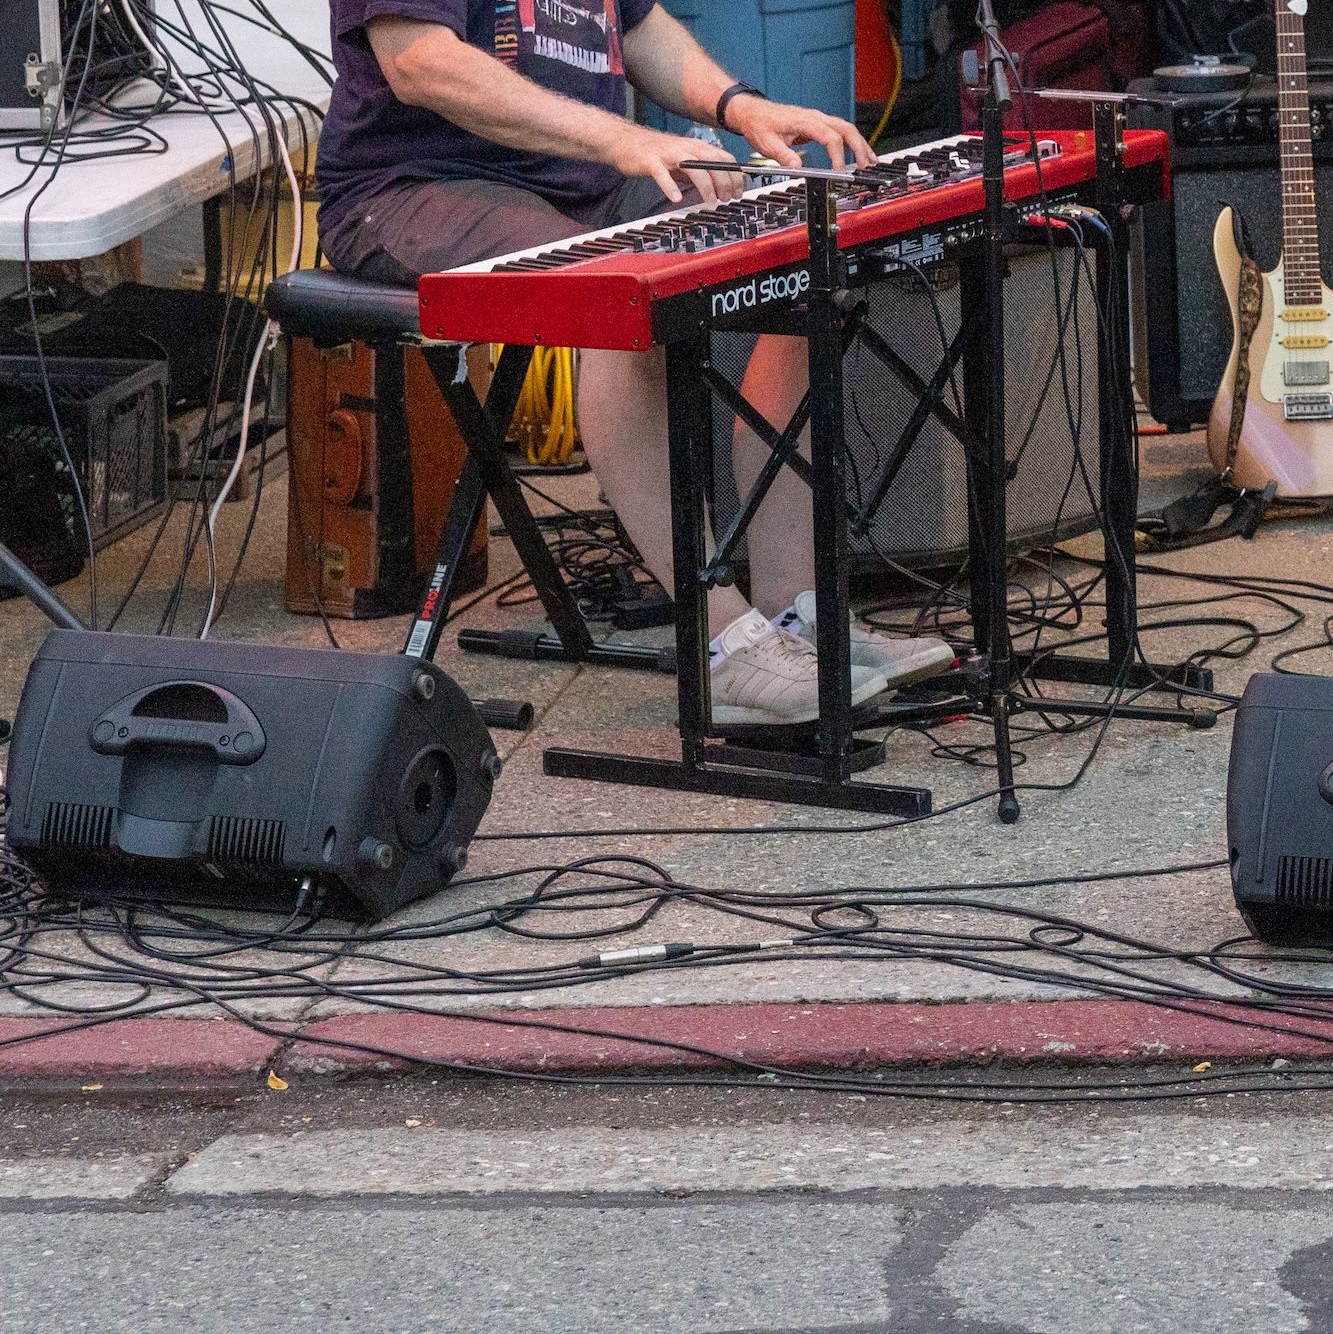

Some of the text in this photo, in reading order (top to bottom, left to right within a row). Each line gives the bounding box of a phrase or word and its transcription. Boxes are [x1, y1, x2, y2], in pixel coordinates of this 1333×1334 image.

[712, 269, 811, 316] nord stage
[421, 562, 448, 620] PROLINE
